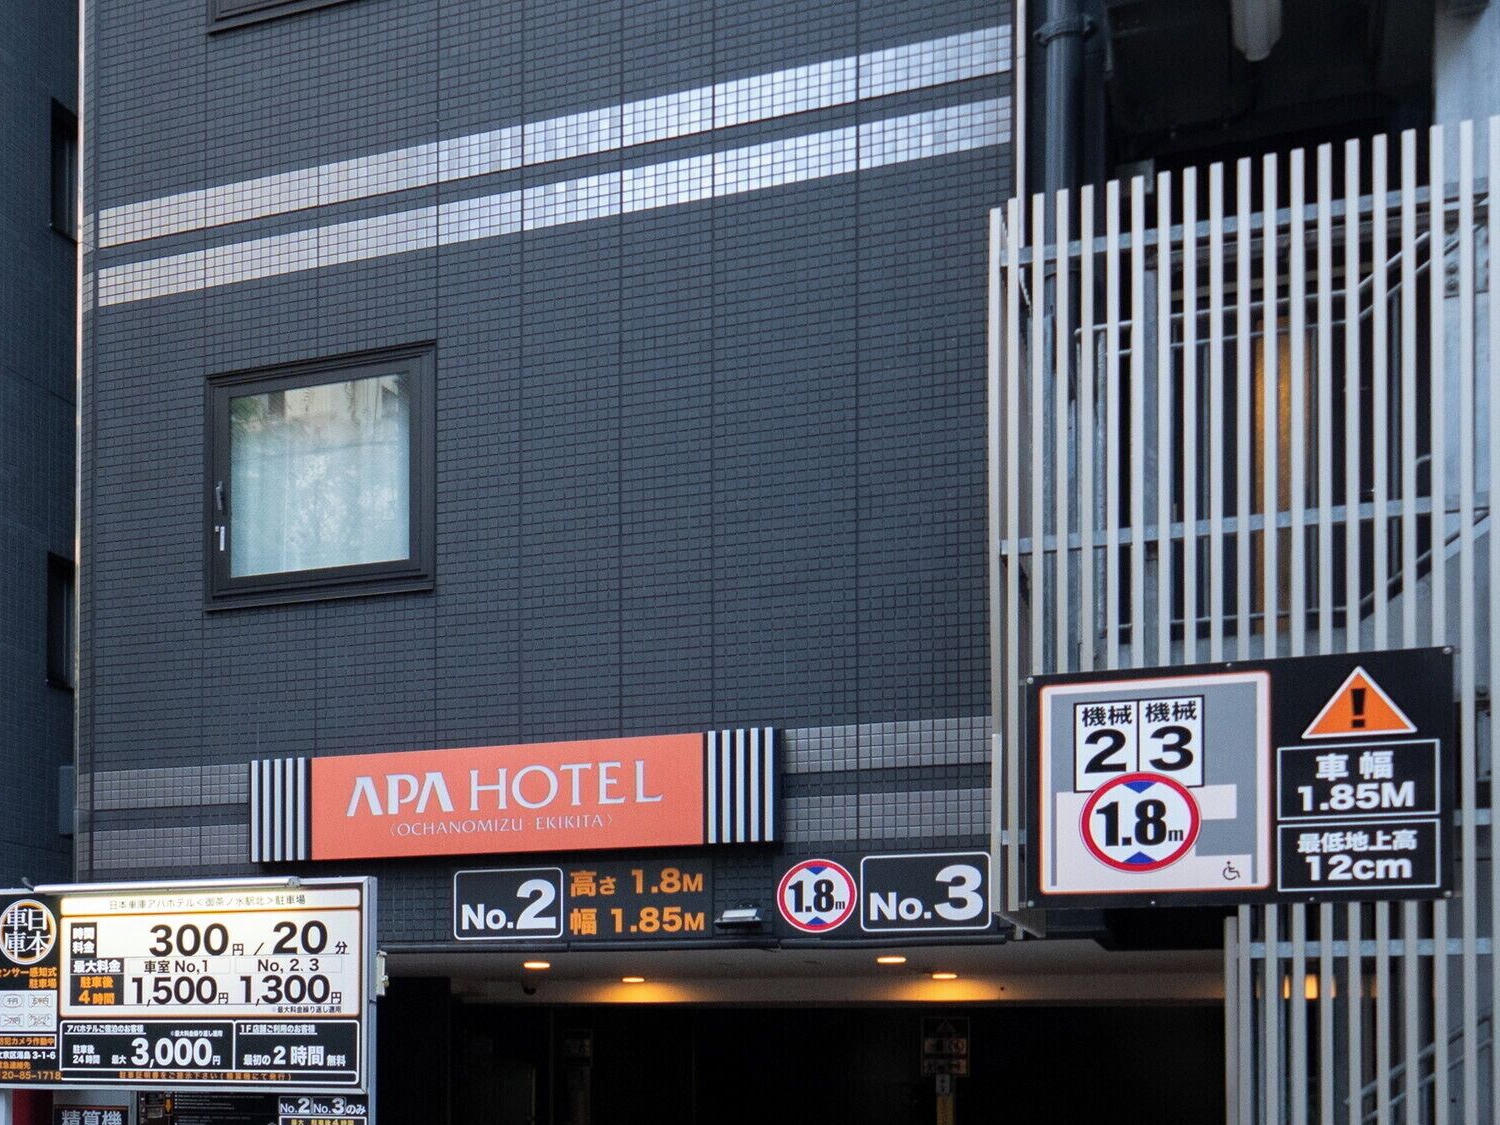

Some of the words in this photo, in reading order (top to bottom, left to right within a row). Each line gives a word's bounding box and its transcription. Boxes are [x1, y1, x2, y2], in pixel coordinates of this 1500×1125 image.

[1081, 704, 1133, 727] 機械
[1145, 700, 1197, 723] 機械
[1084, 729, 1127, 774] 2
[1149, 725, 1194, 771] 3
[346, 772, 454, 817] APA
[469, 760, 664, 812] HOTEL
[1297, 781, 1415, 813] 1.85M
[1095, 798, 1185, 848] 1.8m
[1297, 829, 1418, 854] 最低地上高
[570, 870, 616, 898] 高さ
[631, 867, 703, 894] 1.8M
[1305, 854, 1413, 881] 12cm
[461, 878, 557, 930] No.2
[788, 879, 846, 913] 1.8m
[869, 864, 984, 921] No.3
[72, 927, 95, 940] 時間
[569, 907, 597, 935] 幅
[610, 906, 705, 933] 1.85M
[72, 941, 95, 954] 料金
[73, 960, 121, 973] 最大料金
[80, 976, 114, 988] 駐車後
[144, 960, 170, 974] 車室
[131, 975, 228, 1006] 1,500円
[240, 974, 341, 1006] 1,300円
[131, 1037, 221, 1068] 3,000円
[280, 1097, 310, 1114] No.2
[313, 1097, 344, 1115] No.3
[346, 1104, 367, 1115] のみ
